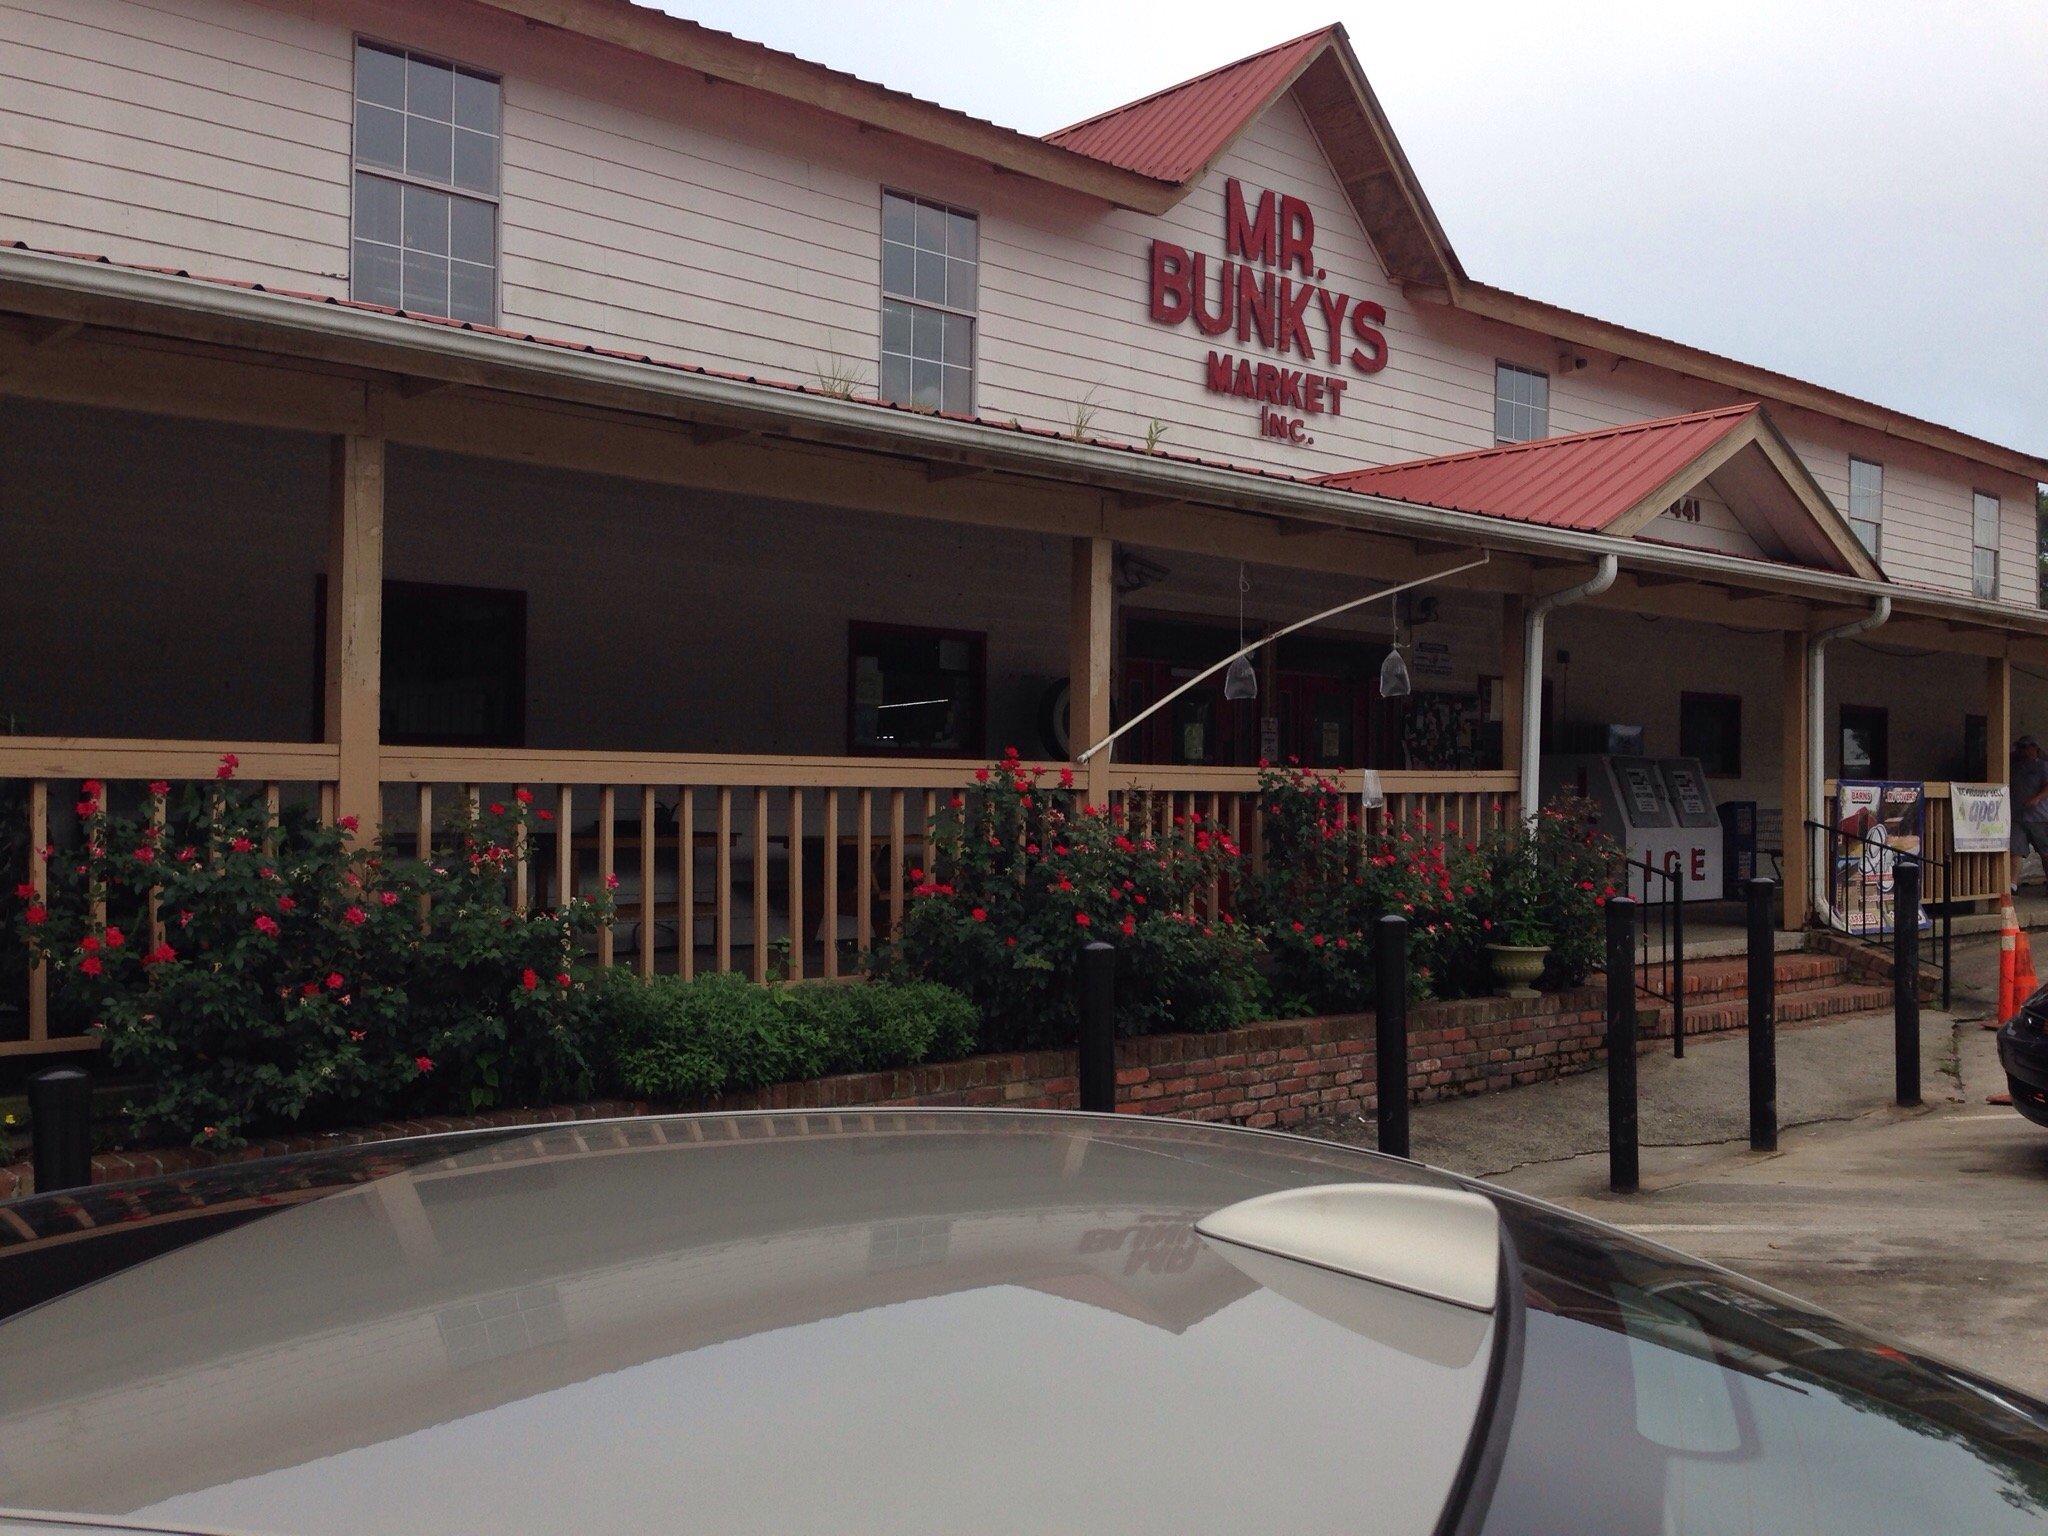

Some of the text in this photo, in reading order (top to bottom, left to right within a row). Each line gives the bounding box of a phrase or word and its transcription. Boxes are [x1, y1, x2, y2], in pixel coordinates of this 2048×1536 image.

[1226, 177, 1327, 280] MR.
[1151, 239, 1389, 374] BUNKYS
[1206, 350, 1348, 416] MARKET
[1661, 498, 1700, 522] 441
[1851, 791, 1871, 801] BARNS
[1644, 847, 1706, 882] ICE
